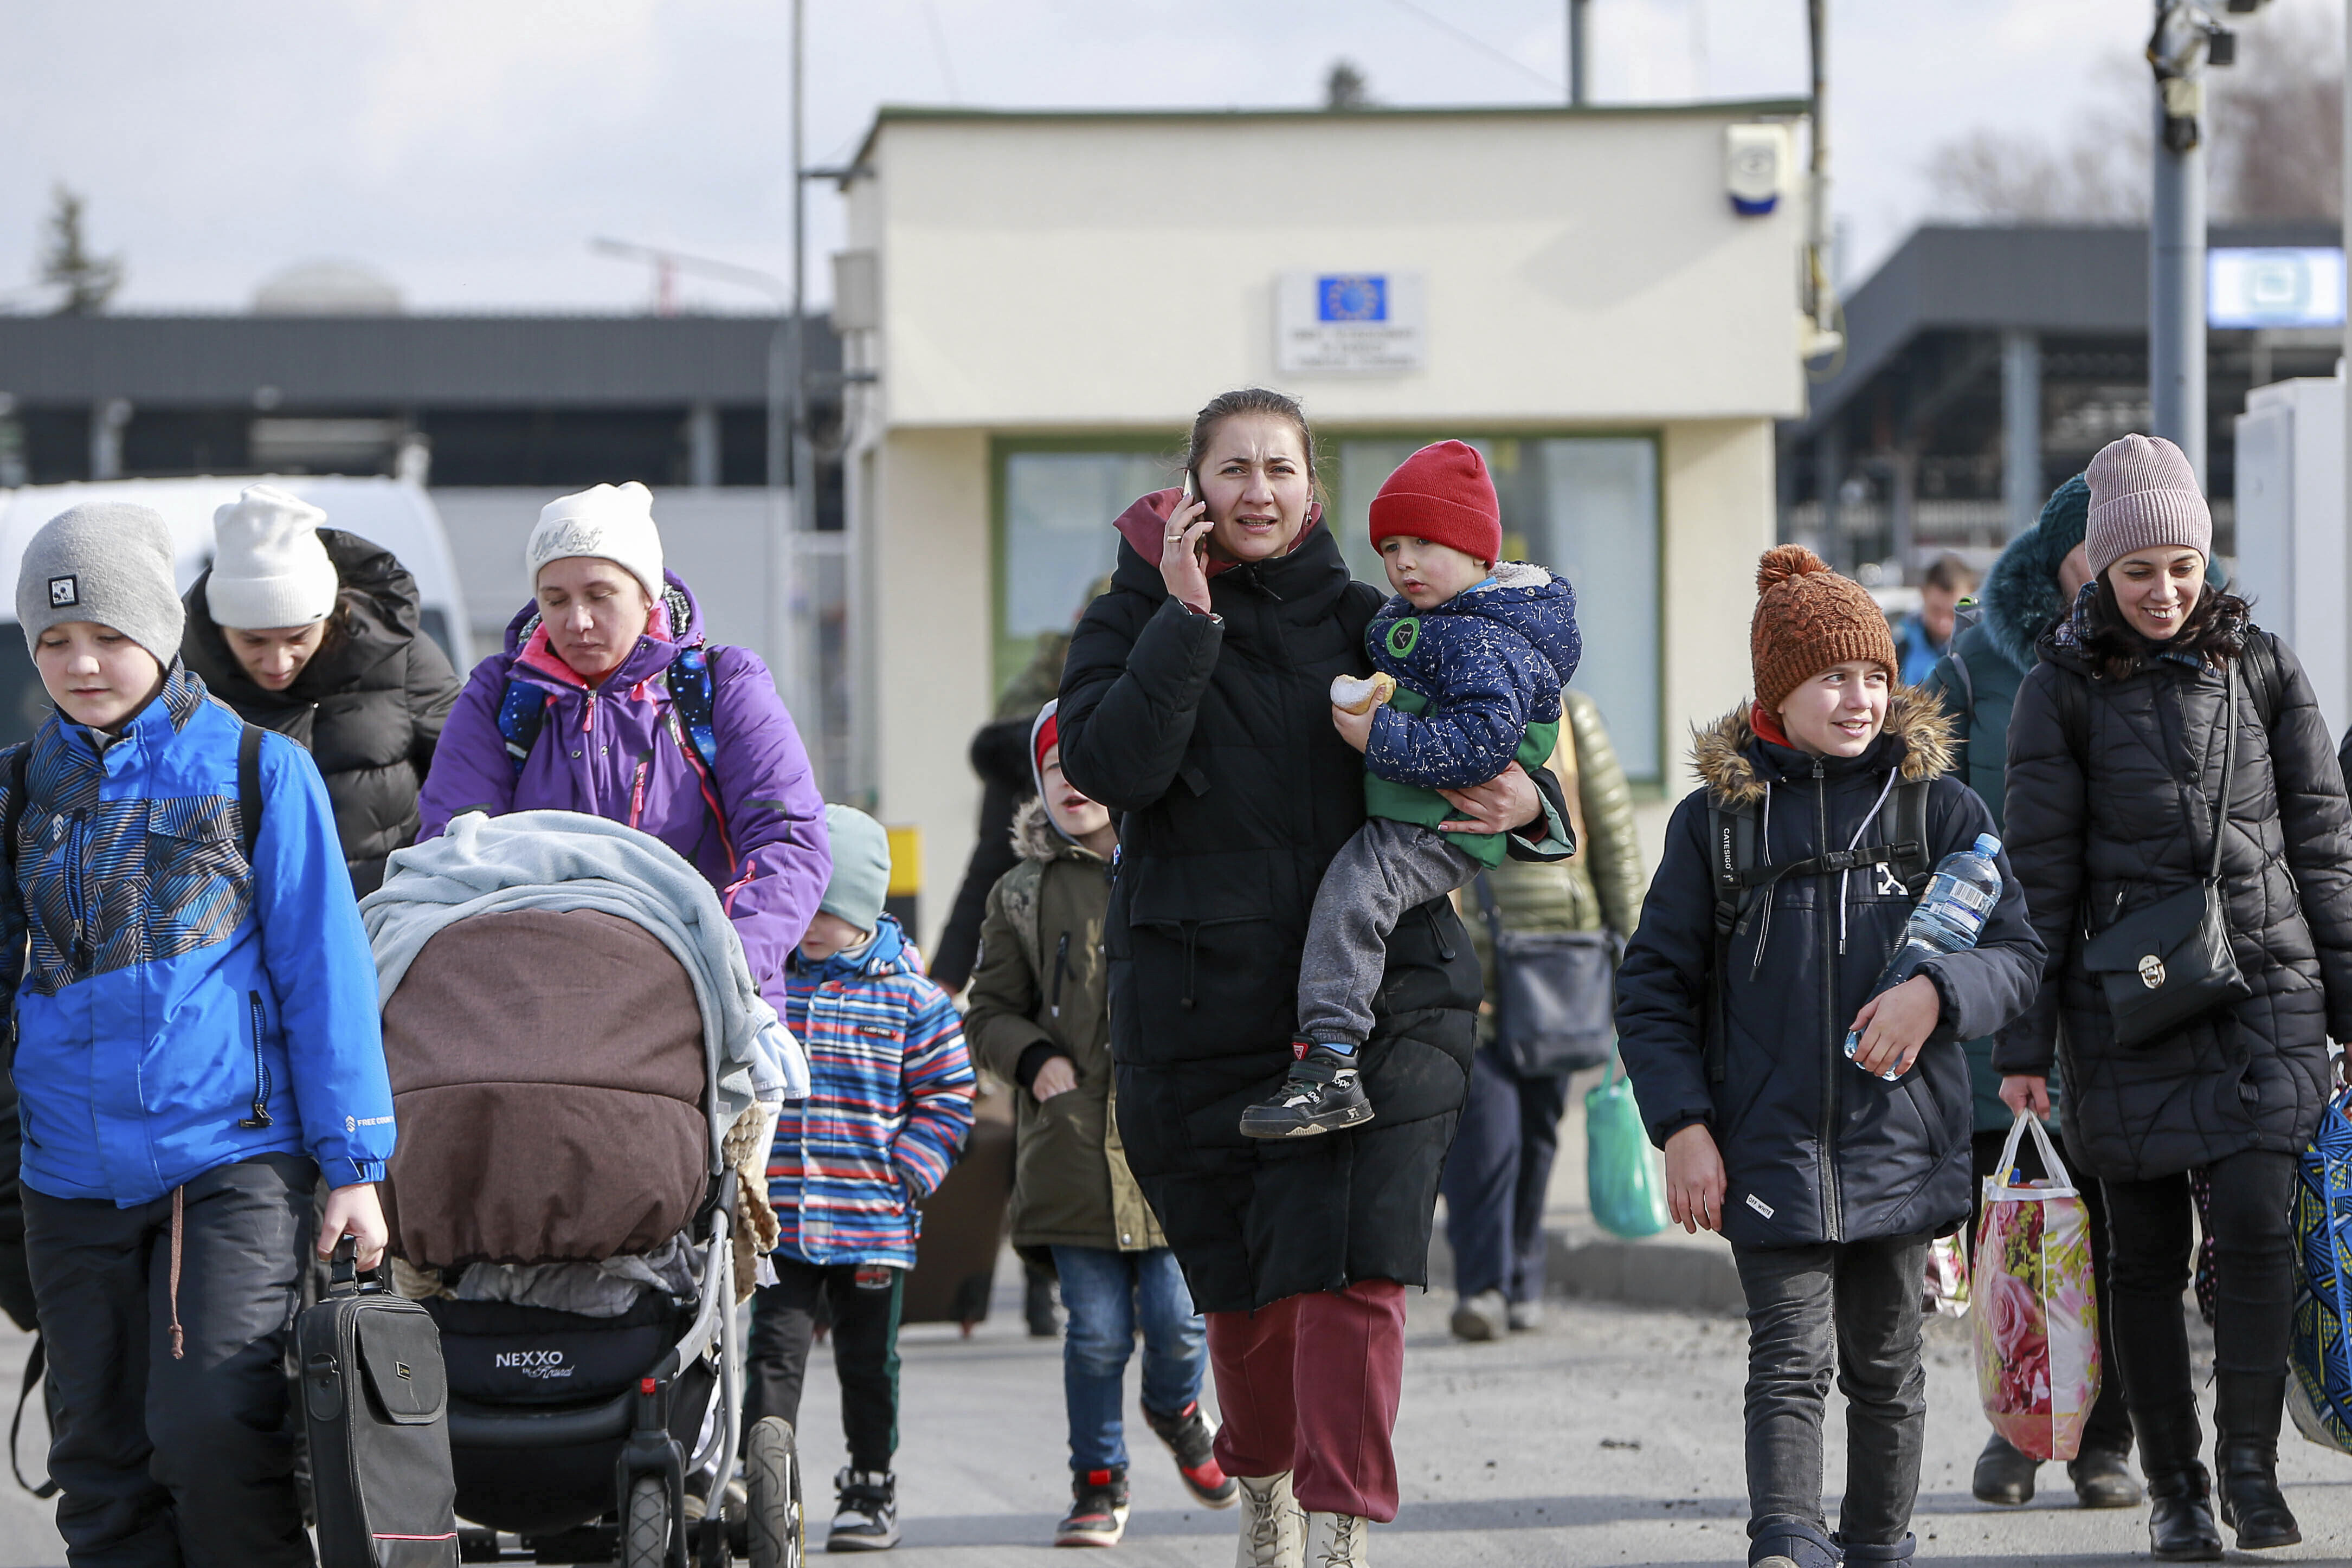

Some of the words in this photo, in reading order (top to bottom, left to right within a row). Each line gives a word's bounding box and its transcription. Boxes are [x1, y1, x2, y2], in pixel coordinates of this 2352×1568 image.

[1723, 828, 1731, 869] CATESIGO
[357, 1118, 376, 1127] FREE
[1748, 1197, 1757, 1205] OFF
[1758, 1203, 1771, 1216] WHITE
[496, 1350, 563, 1367] NEXXO
